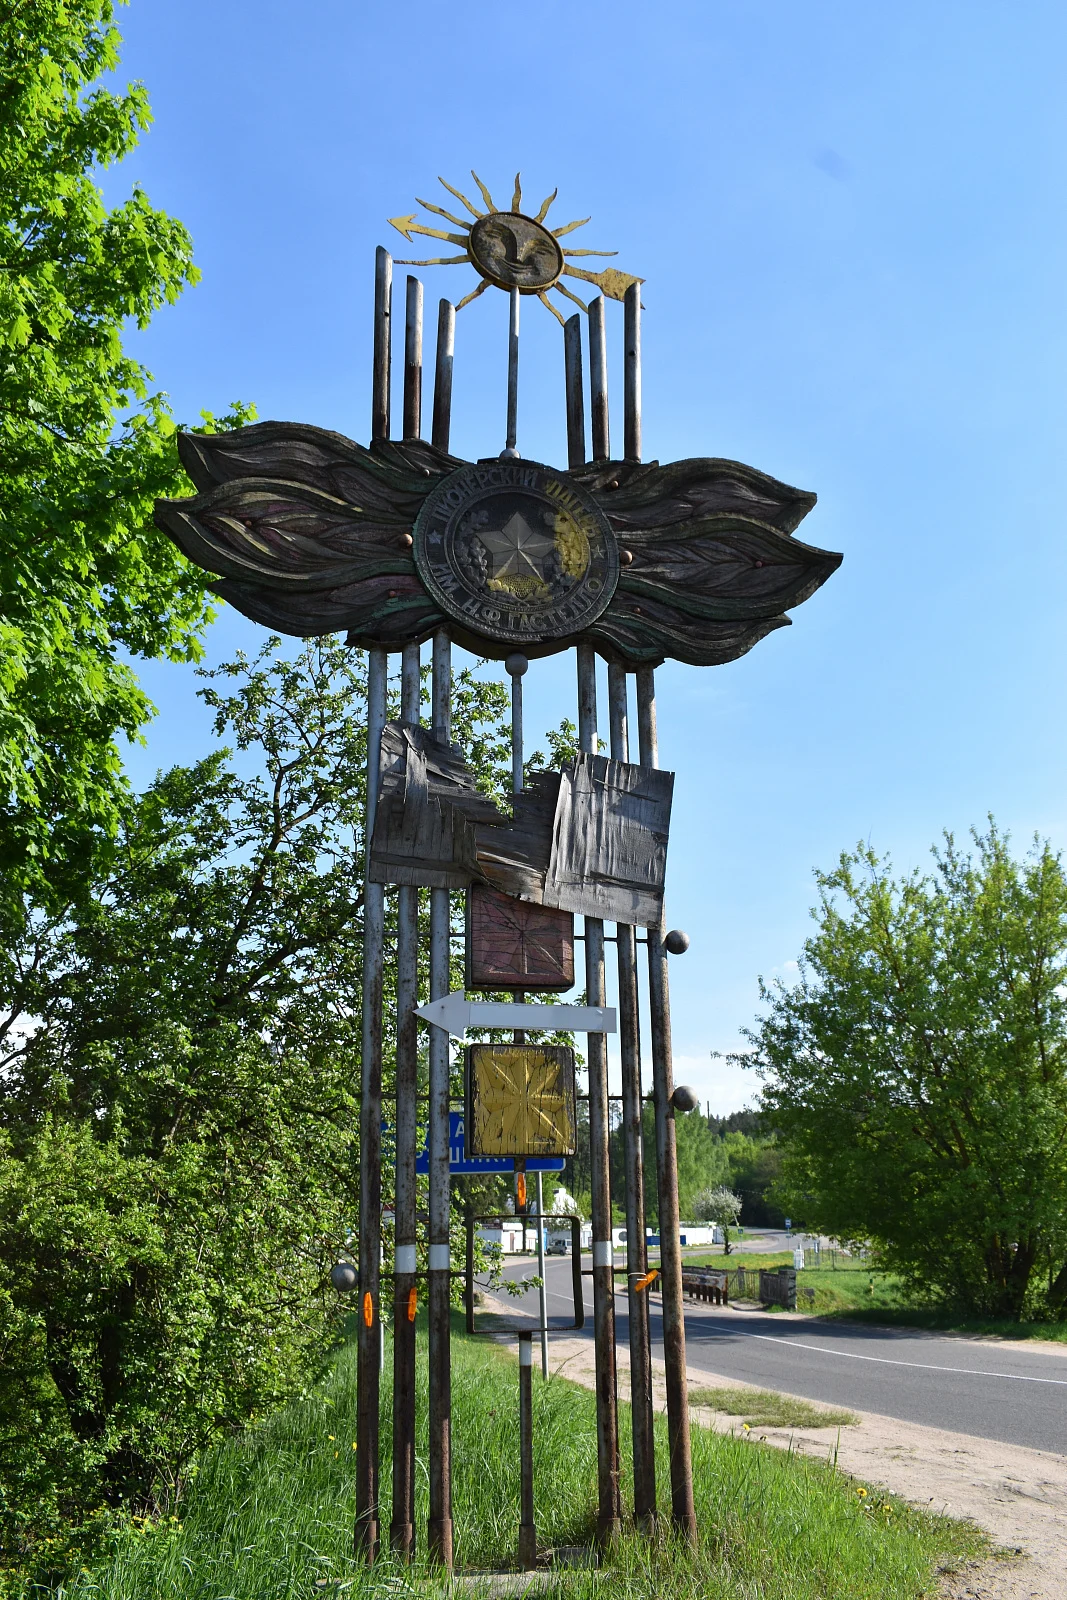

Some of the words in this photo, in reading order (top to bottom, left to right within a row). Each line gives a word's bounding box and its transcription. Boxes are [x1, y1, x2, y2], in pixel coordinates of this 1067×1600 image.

[431, 467, 539, 523] ПИОНЕРСКИЙ
[544, 478, 602, 539] ЛАГЕРЬ
[508, 577, 604, 632] ГАСТЕЛЛО
